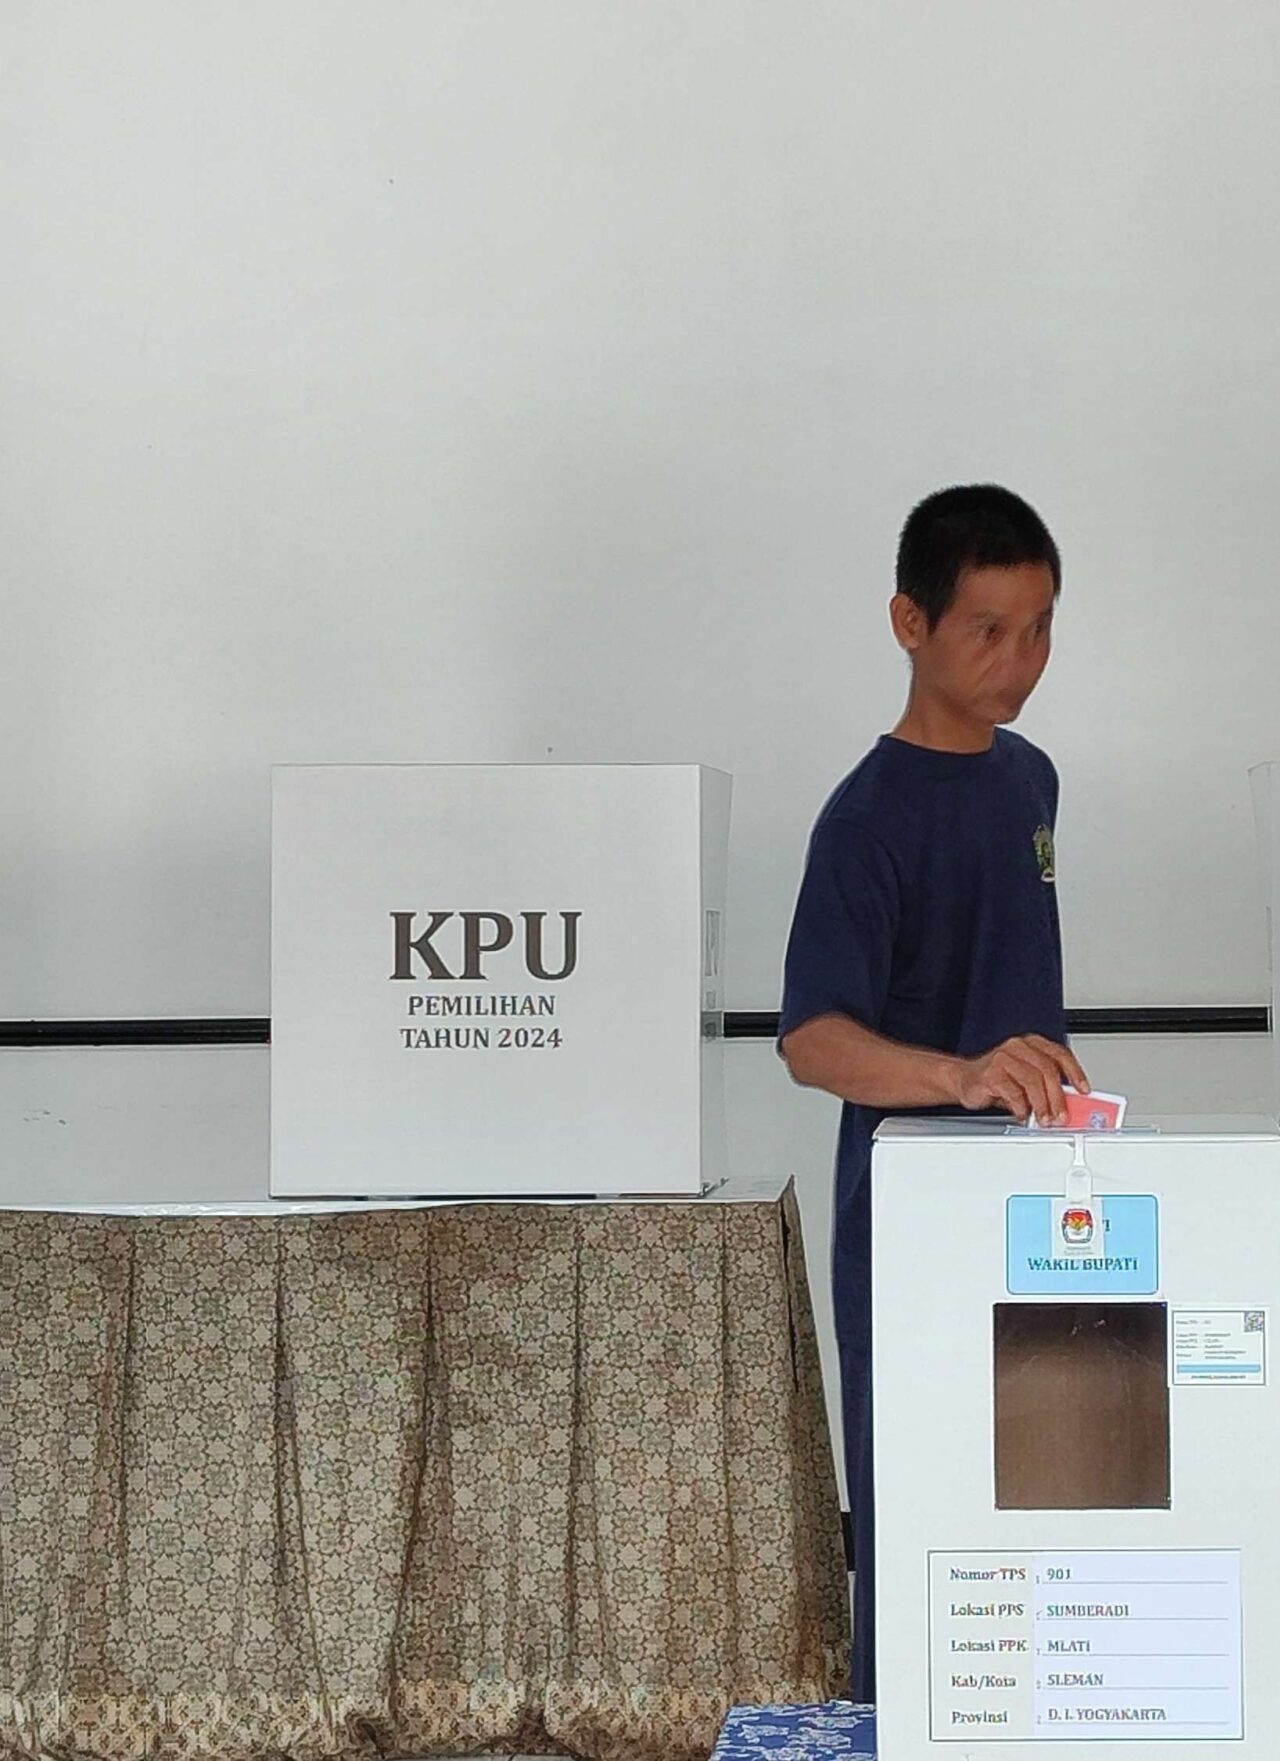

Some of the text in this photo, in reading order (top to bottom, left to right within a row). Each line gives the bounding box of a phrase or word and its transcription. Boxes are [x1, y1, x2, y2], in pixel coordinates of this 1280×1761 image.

[389, 911, 583, 981] KPU
[408, 995, 556, 1016] PEMILIHAN
[400, 1027, 564, 1049] TAHUN 2024
[1027, 1257, 1079, 1272] WAKIL
[950, 1567, 998, 1581] Nomor
[1000, 1567, 1027, 1581] TPS
[1047, 1567, 1071, 1581] 901
[950, 1603, 995, 1617] Lokasi
[998, 1603, 1025, 1618] PPS
[1046, 1604, 1130, 1617] SUMBERADI
[951, 1639, 996, 1652] Lokasi
[998, 1639, 1028, 1652] PPK
[1047, 1640, 1091, 1653] MLATI
[951, 1674, 1017, 1691] Kab/Kota
[1047, 1673, 1104, 1686] SLEMAN
[951, 1710, 1009, 1725] Provinsi
[1076, 1707, 1168, 1721] YOGYAKARTA
